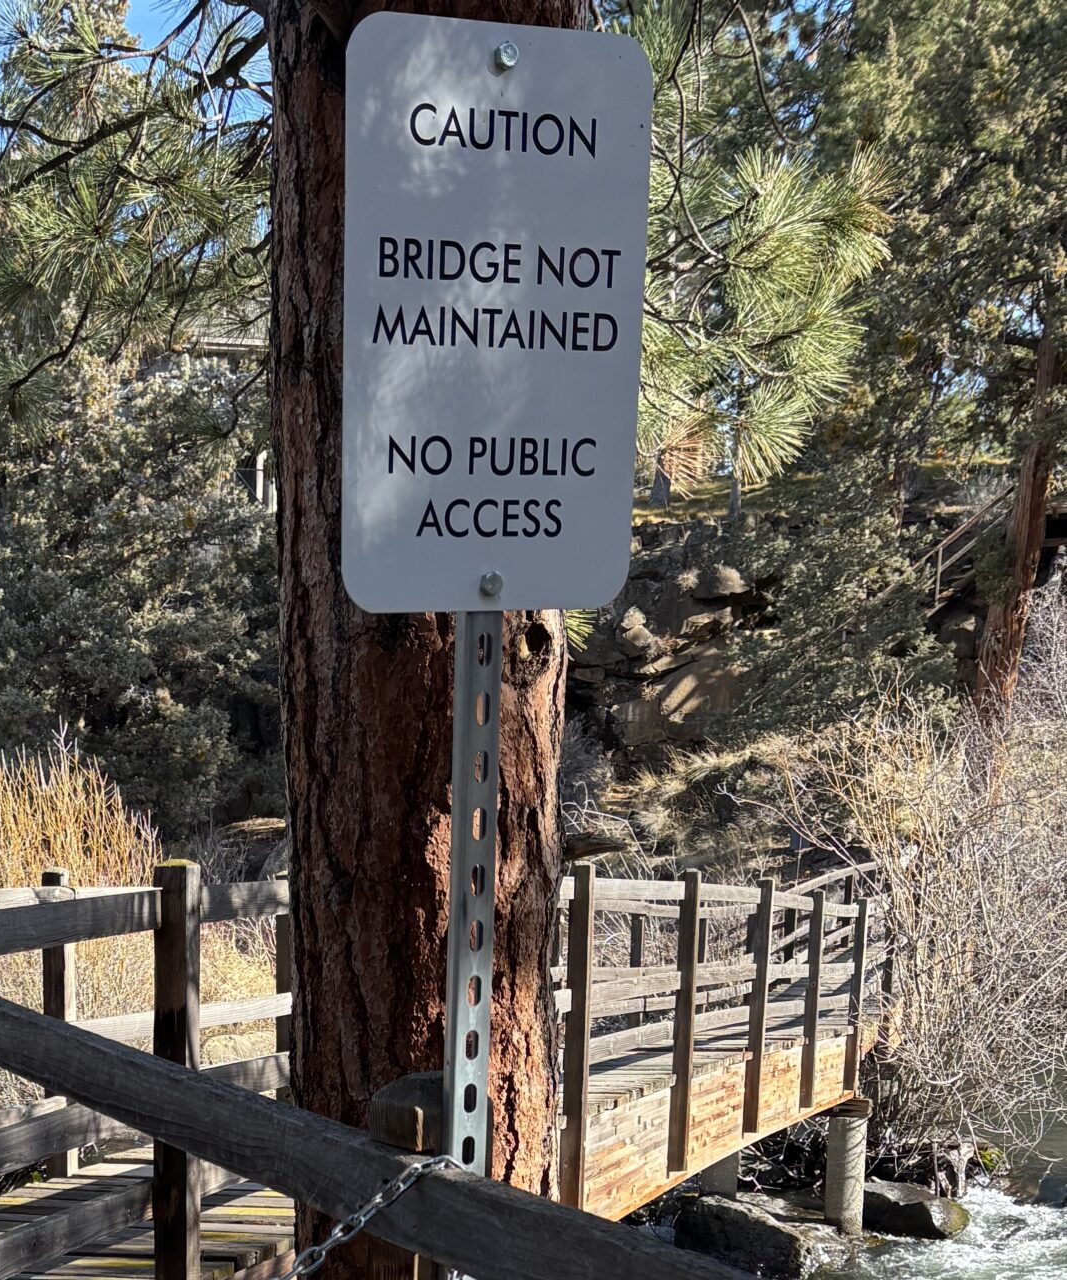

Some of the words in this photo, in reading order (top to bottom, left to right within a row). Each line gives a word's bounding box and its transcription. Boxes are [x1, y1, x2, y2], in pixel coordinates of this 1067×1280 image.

[410, 103, 597, 159] CAUTION
[379, 236, 522, 284] BRIDGE
[537, 245, 622, 289] NOT
[372, 303, 618, 352] MAINTAINED
[388, 435, 453, 476] NO
[468, 436, 597, 477] PUBLIC
[415, 498, 562, 538] ACCESS
